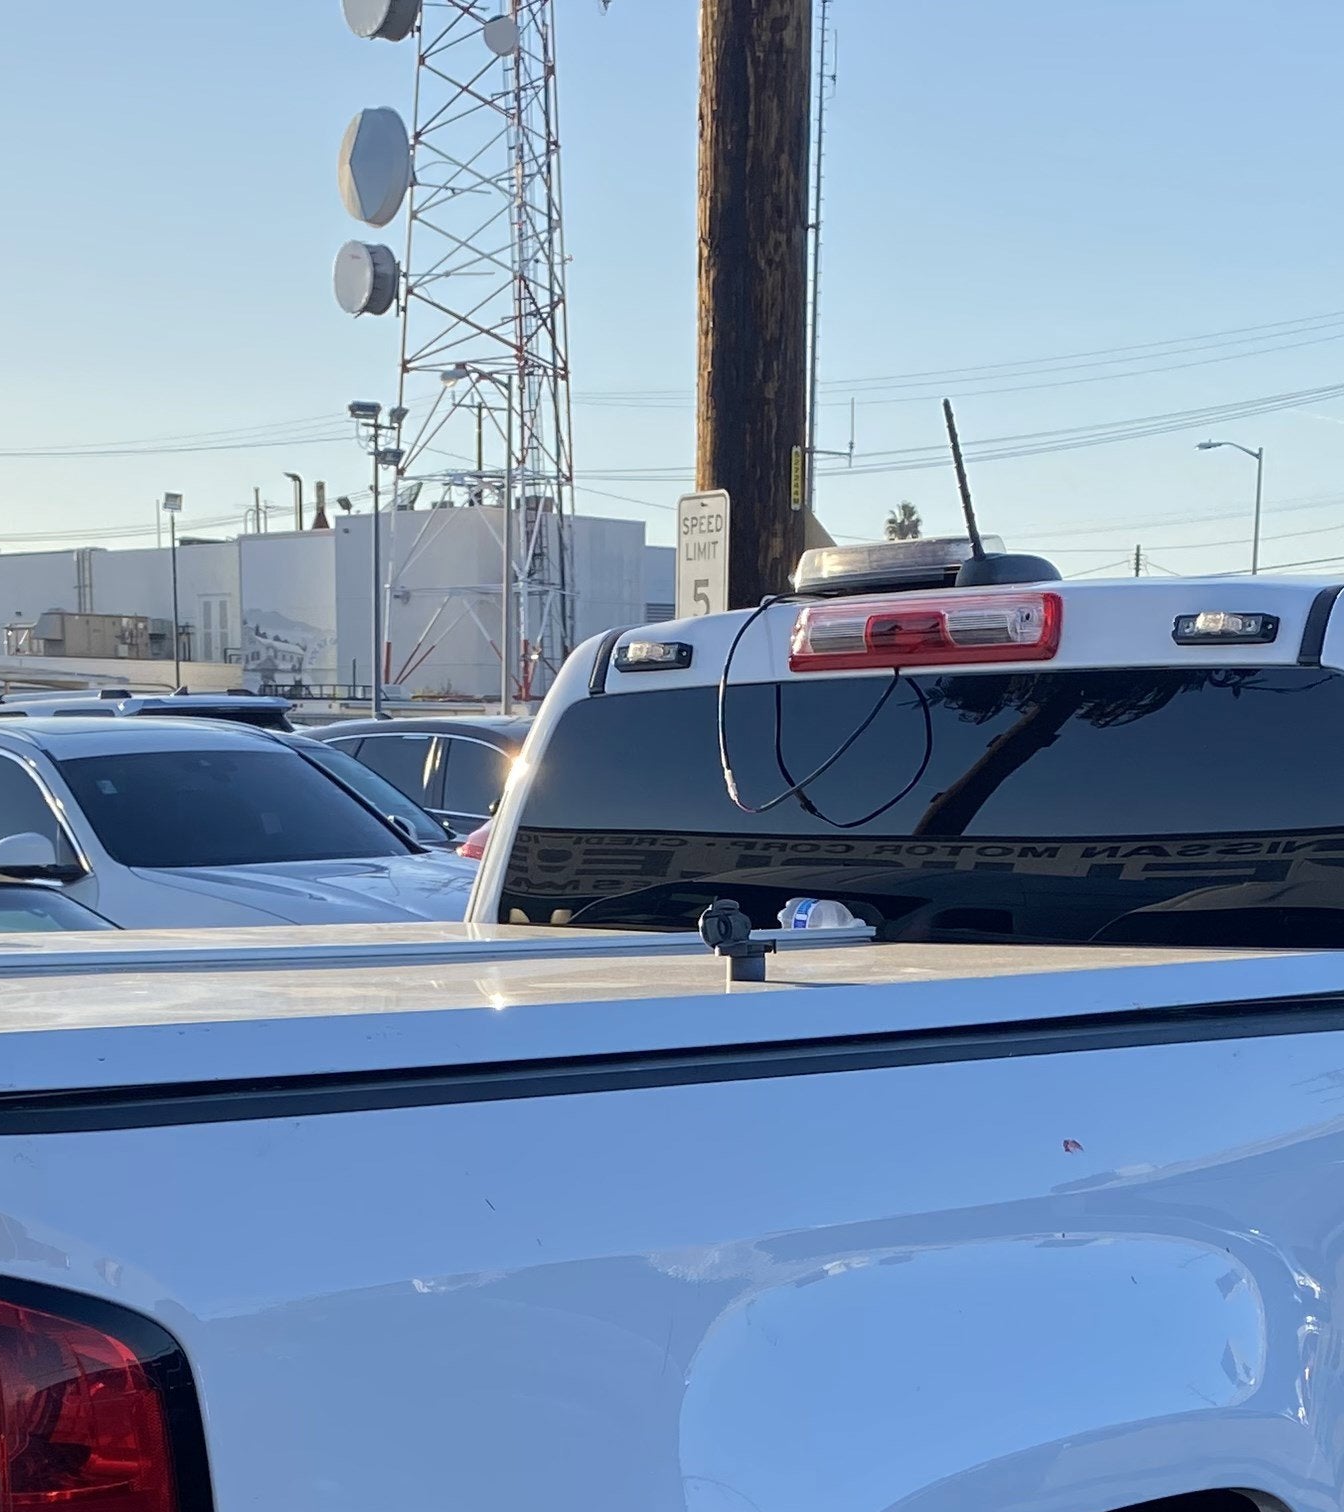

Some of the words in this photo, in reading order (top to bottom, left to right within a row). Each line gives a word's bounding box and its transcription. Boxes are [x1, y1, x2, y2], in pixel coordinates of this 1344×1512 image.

[682, 514, 723, 535] SPEED
[685, 541, 718, 561] LIMIT
[693, 579, 710, 617] 5
